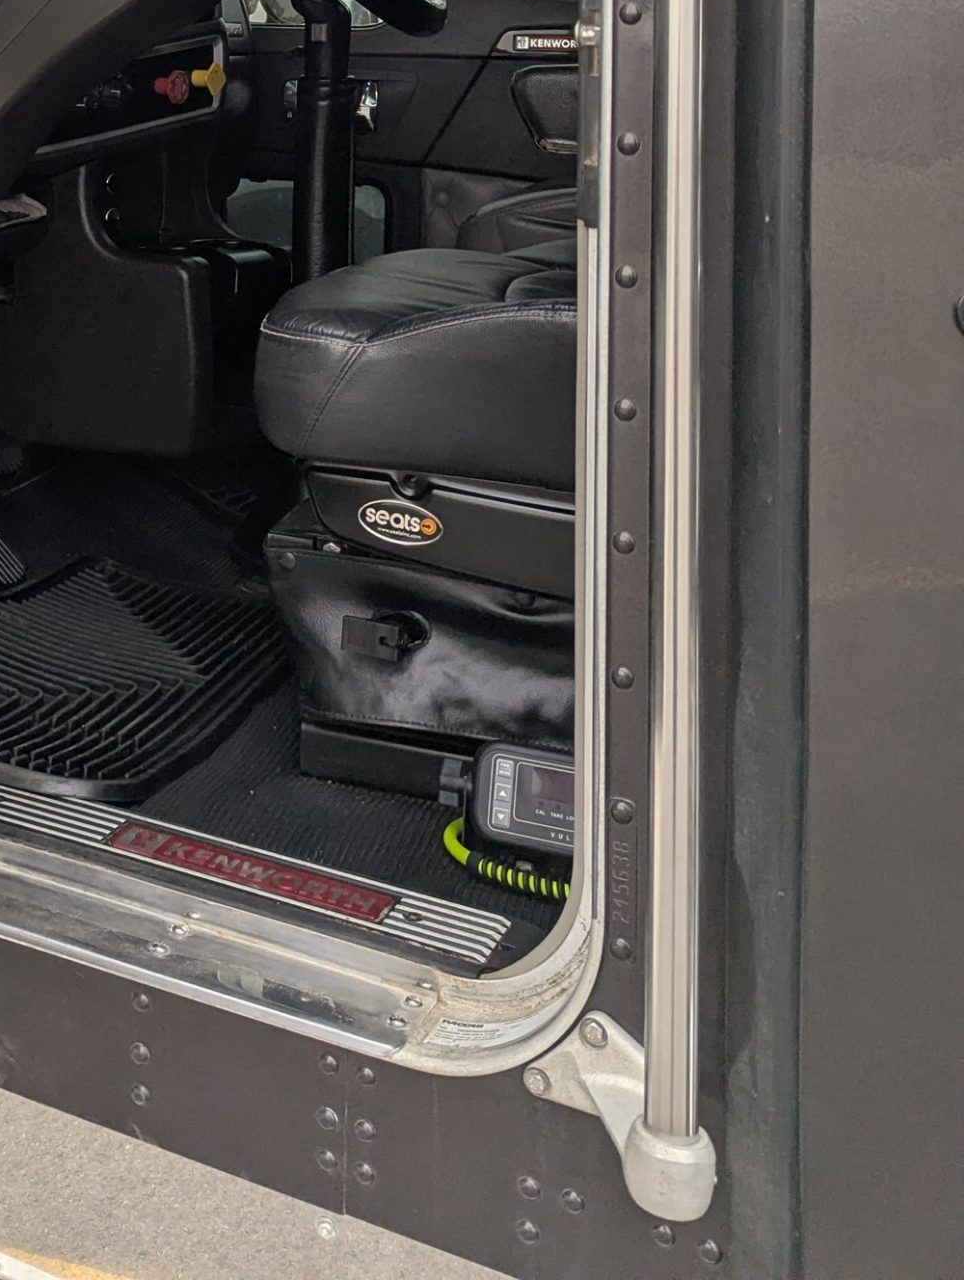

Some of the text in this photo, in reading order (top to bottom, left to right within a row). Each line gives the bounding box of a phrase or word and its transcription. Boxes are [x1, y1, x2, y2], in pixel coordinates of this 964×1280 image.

[530, 39, 577, 48] KENWOR
[365, 507, 420, 532] seats
[550, 831, 571, 841] VUL
[164, 841, 379, 913] KENWORTH
